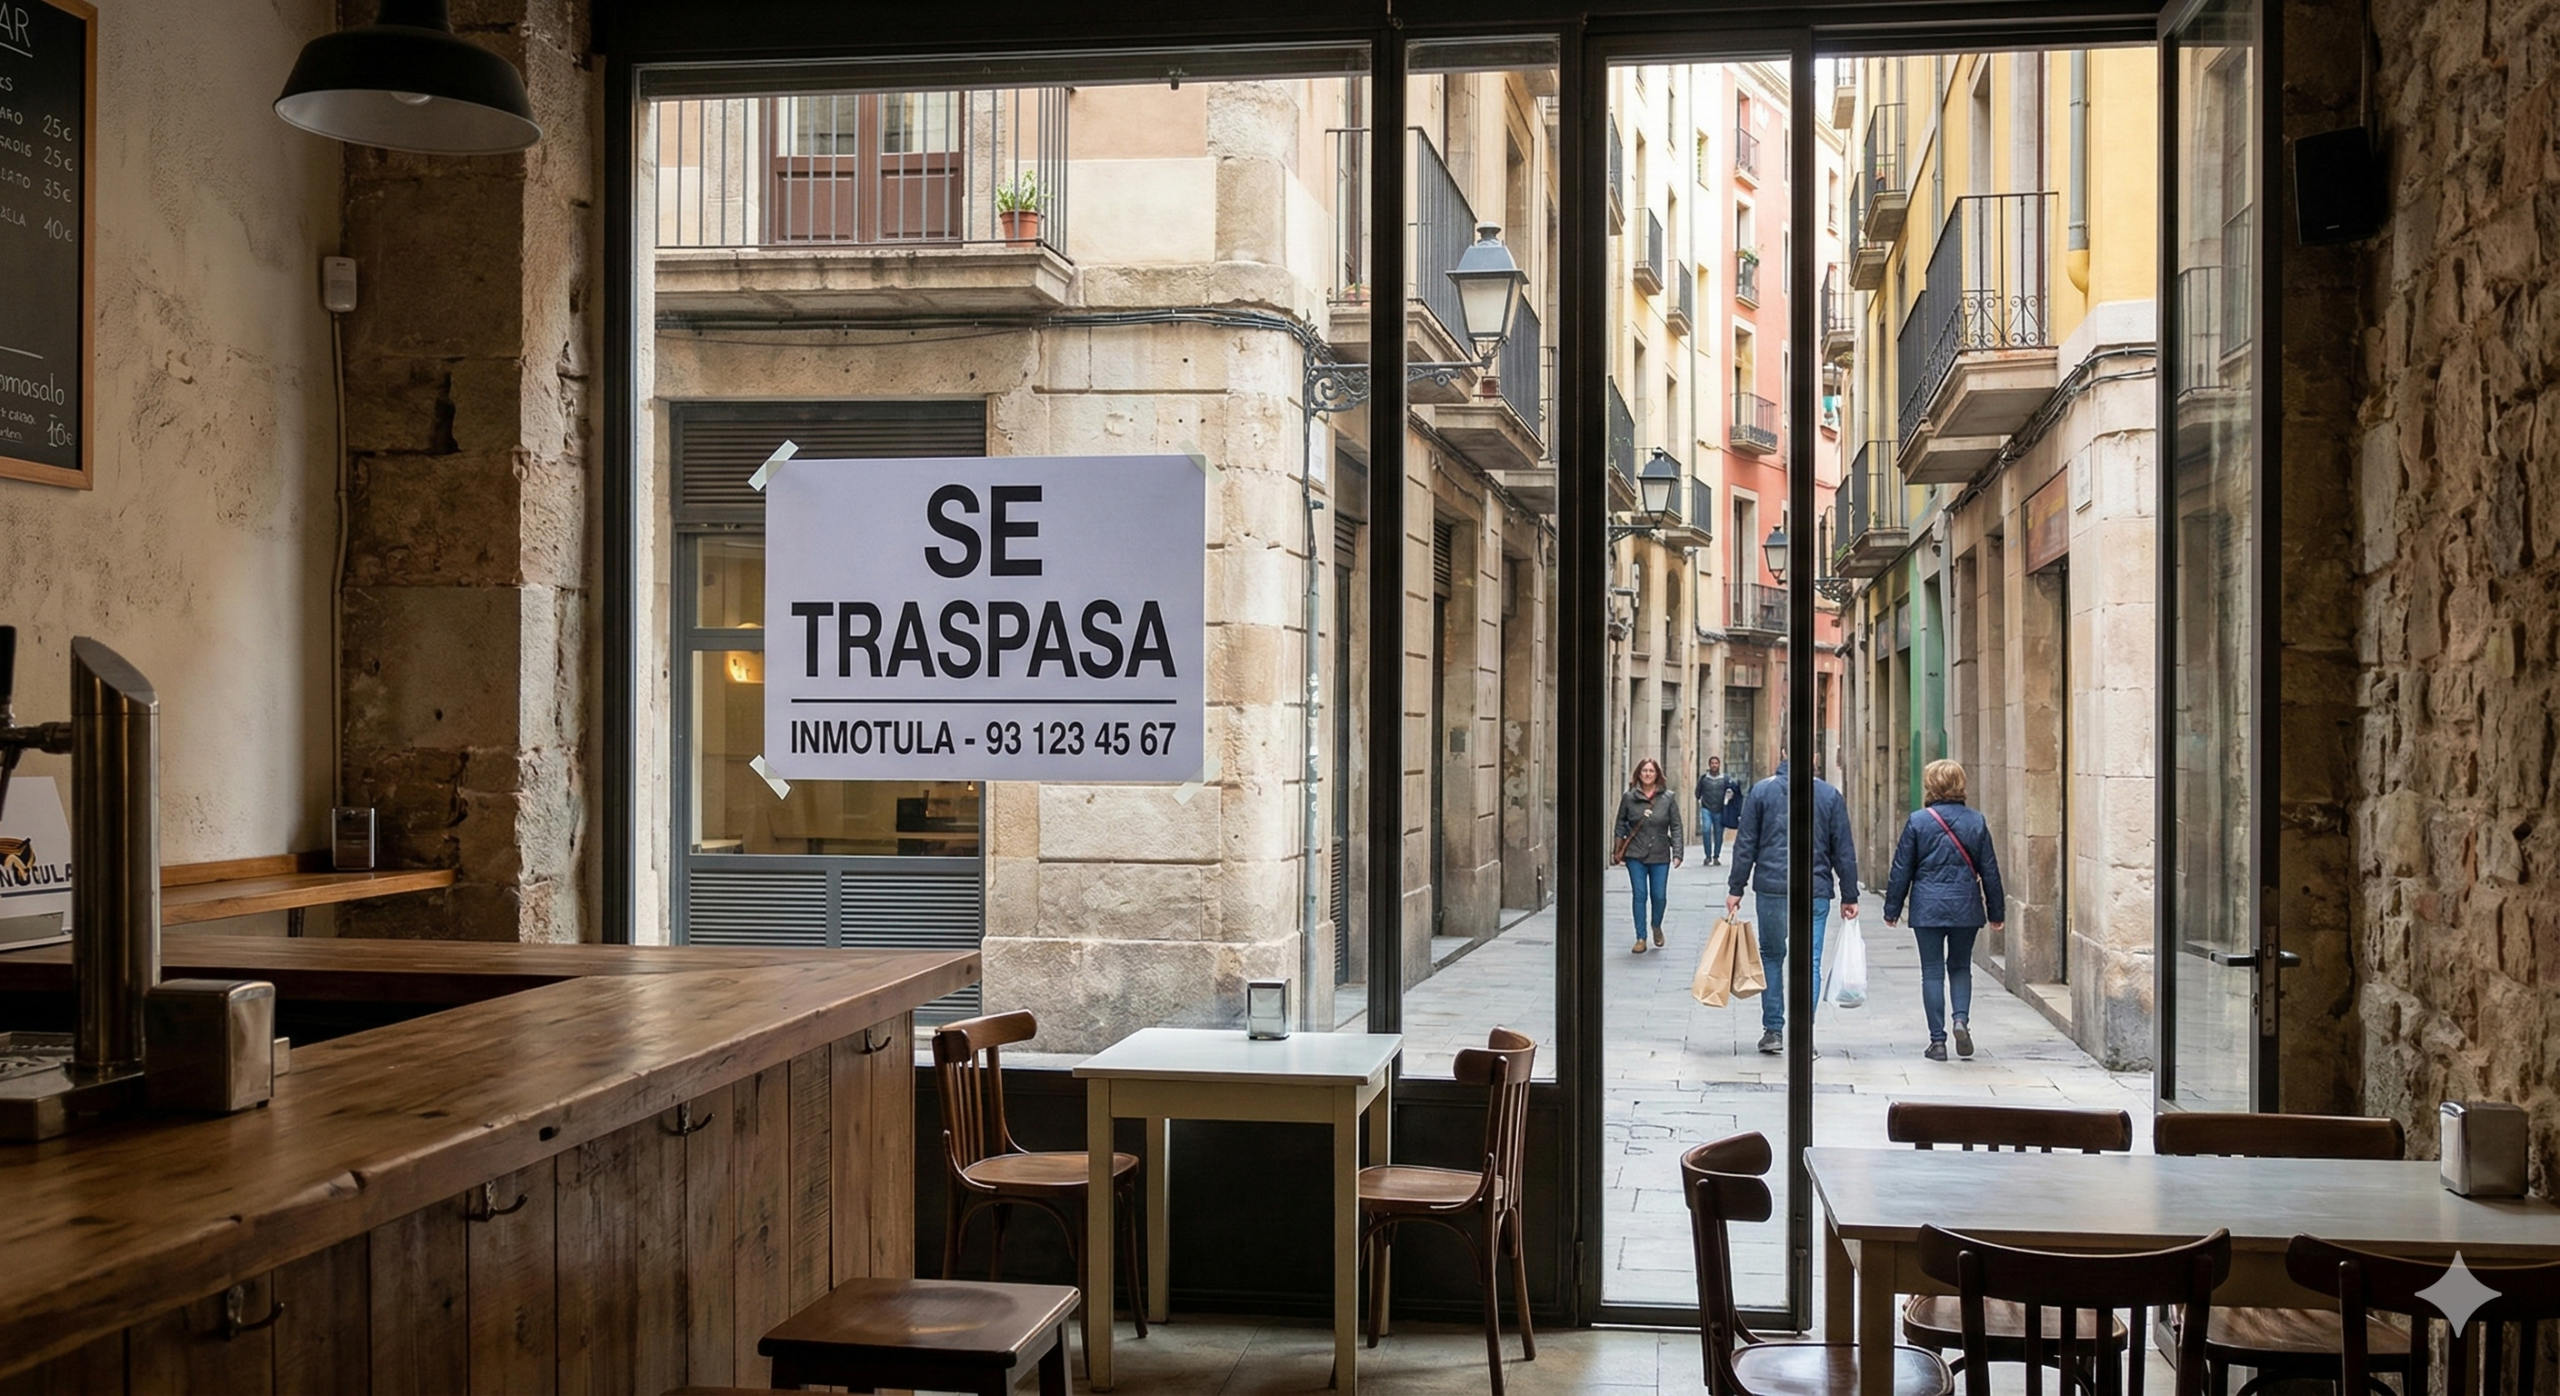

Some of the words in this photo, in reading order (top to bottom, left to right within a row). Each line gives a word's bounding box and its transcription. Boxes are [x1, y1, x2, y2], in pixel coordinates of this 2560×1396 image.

[42, 114, 72, 142] 25€
[43, 146, 73, 172] 25€
[43, 178, 72, 203] 35€
[924, 483, 1043, 579] SE
[791, 599, 1178, 680] TRASPASA
[791, 719, 956, 756] INMOTULA
[985, 720, 1022, 756] 93
[1032, 720, 1085, 756] 123
[1094, 720, 1131, 756] 45
[1140, 720, 1177, 756] 67
